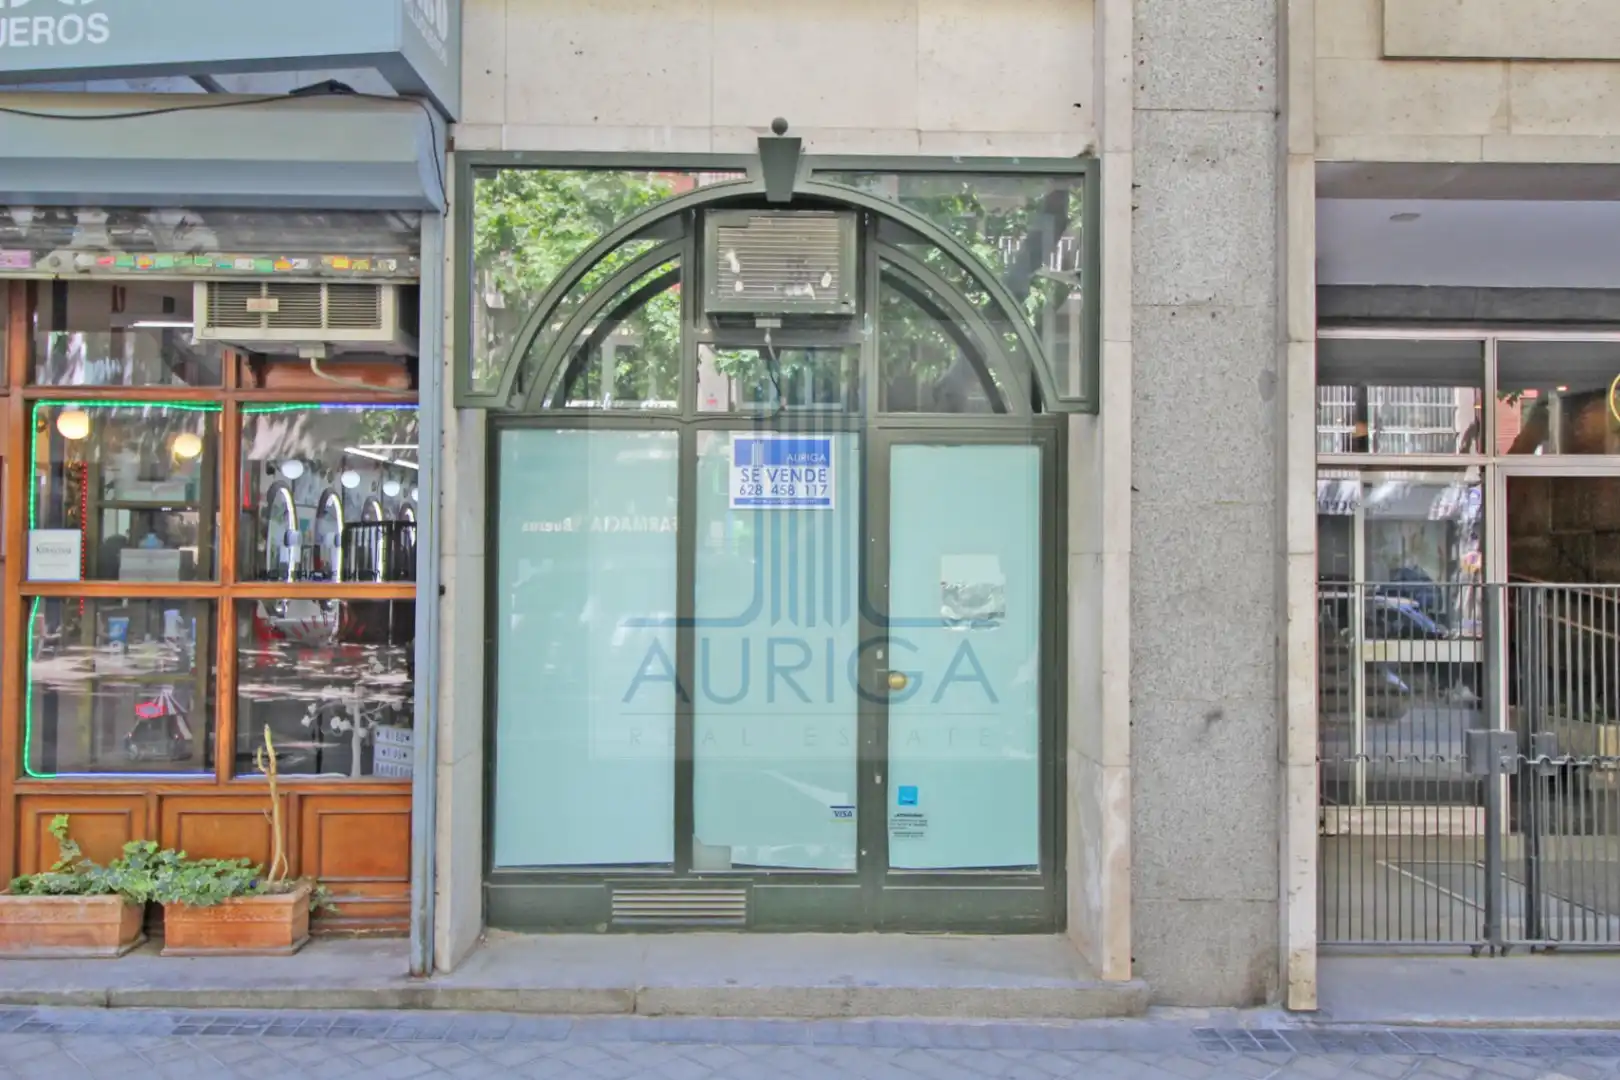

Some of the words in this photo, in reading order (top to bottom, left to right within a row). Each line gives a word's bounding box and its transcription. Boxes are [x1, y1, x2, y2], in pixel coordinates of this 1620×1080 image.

[787, 453, 827, 462] AURIGA
[741, 469, 761, 483] SE
[767, 469, 827, 483] VENDE
[739, 484, 763, 496] 628
[771, 484, 796, 496] 458
[805, 484, 828, 496] 117
[834, 810, 853, 818] VISA
